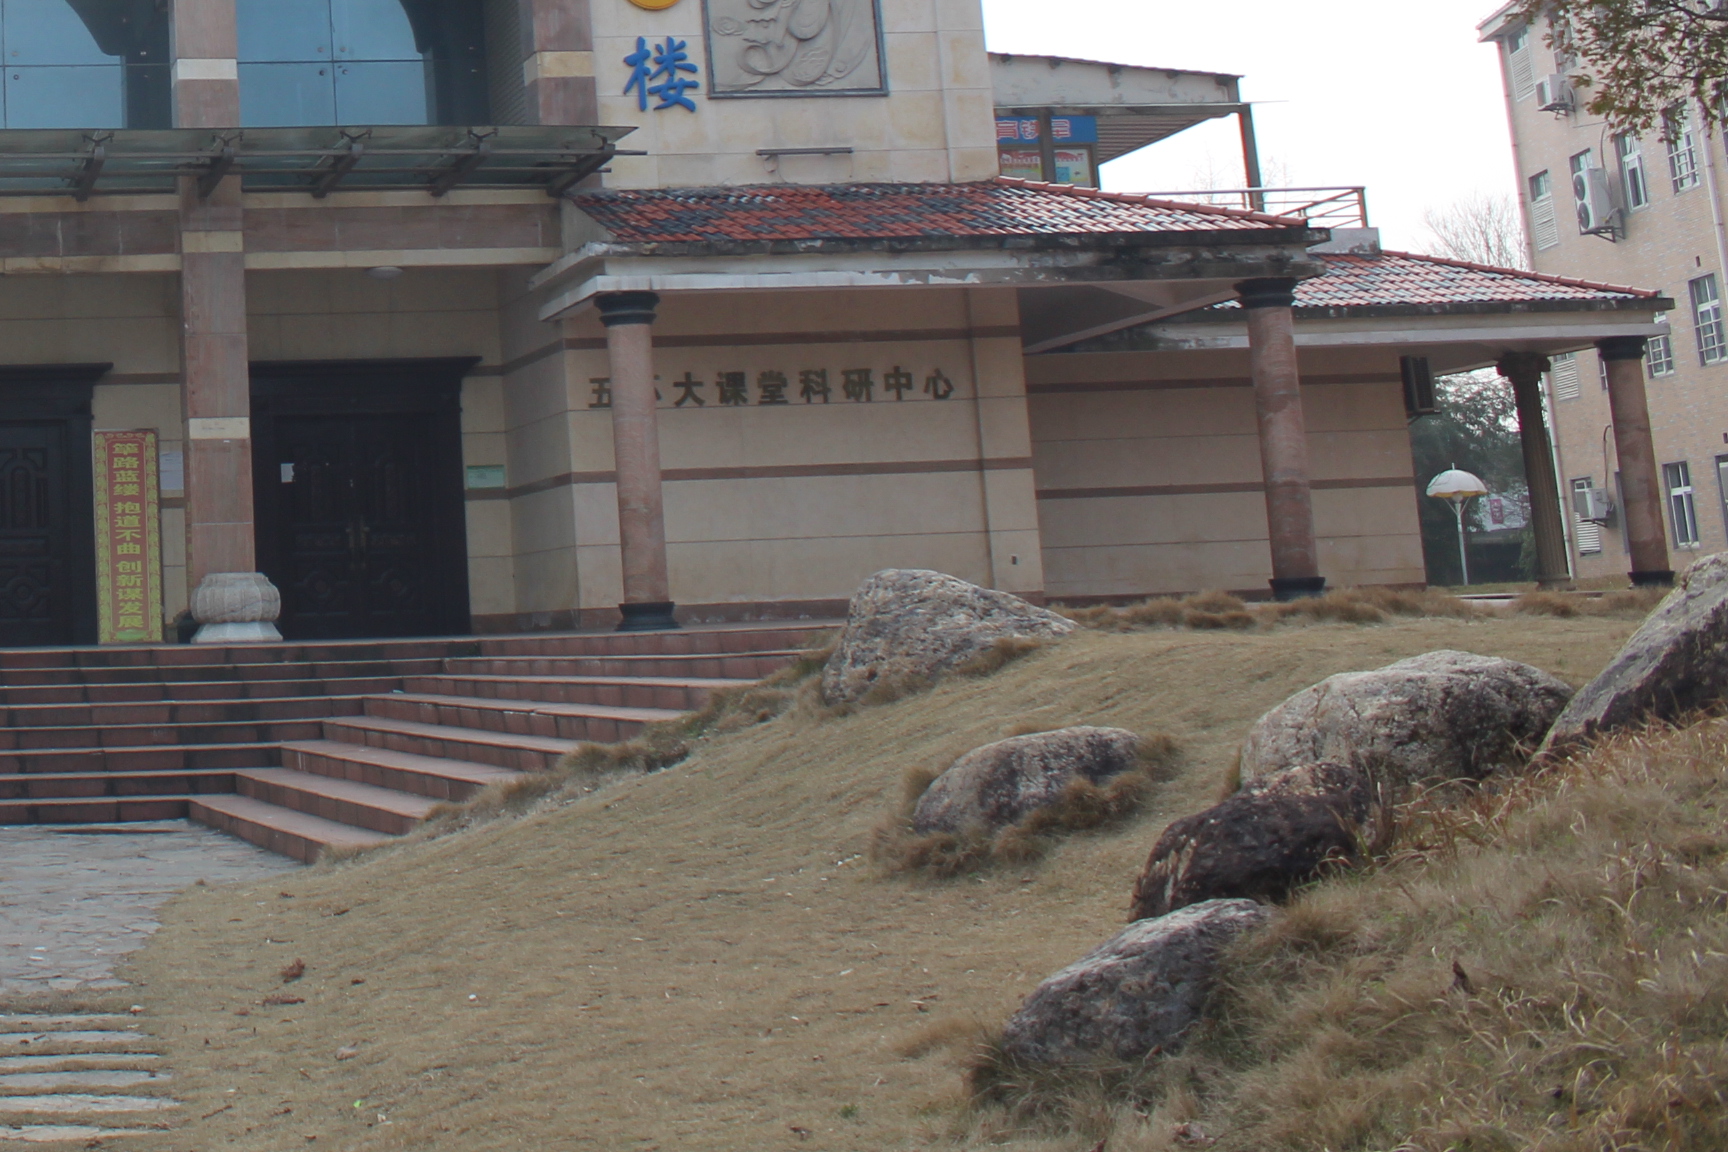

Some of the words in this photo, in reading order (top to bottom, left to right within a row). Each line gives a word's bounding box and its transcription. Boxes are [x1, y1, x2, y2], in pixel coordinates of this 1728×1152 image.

[588, 365, 954, 409] 五大课堂科研中心
